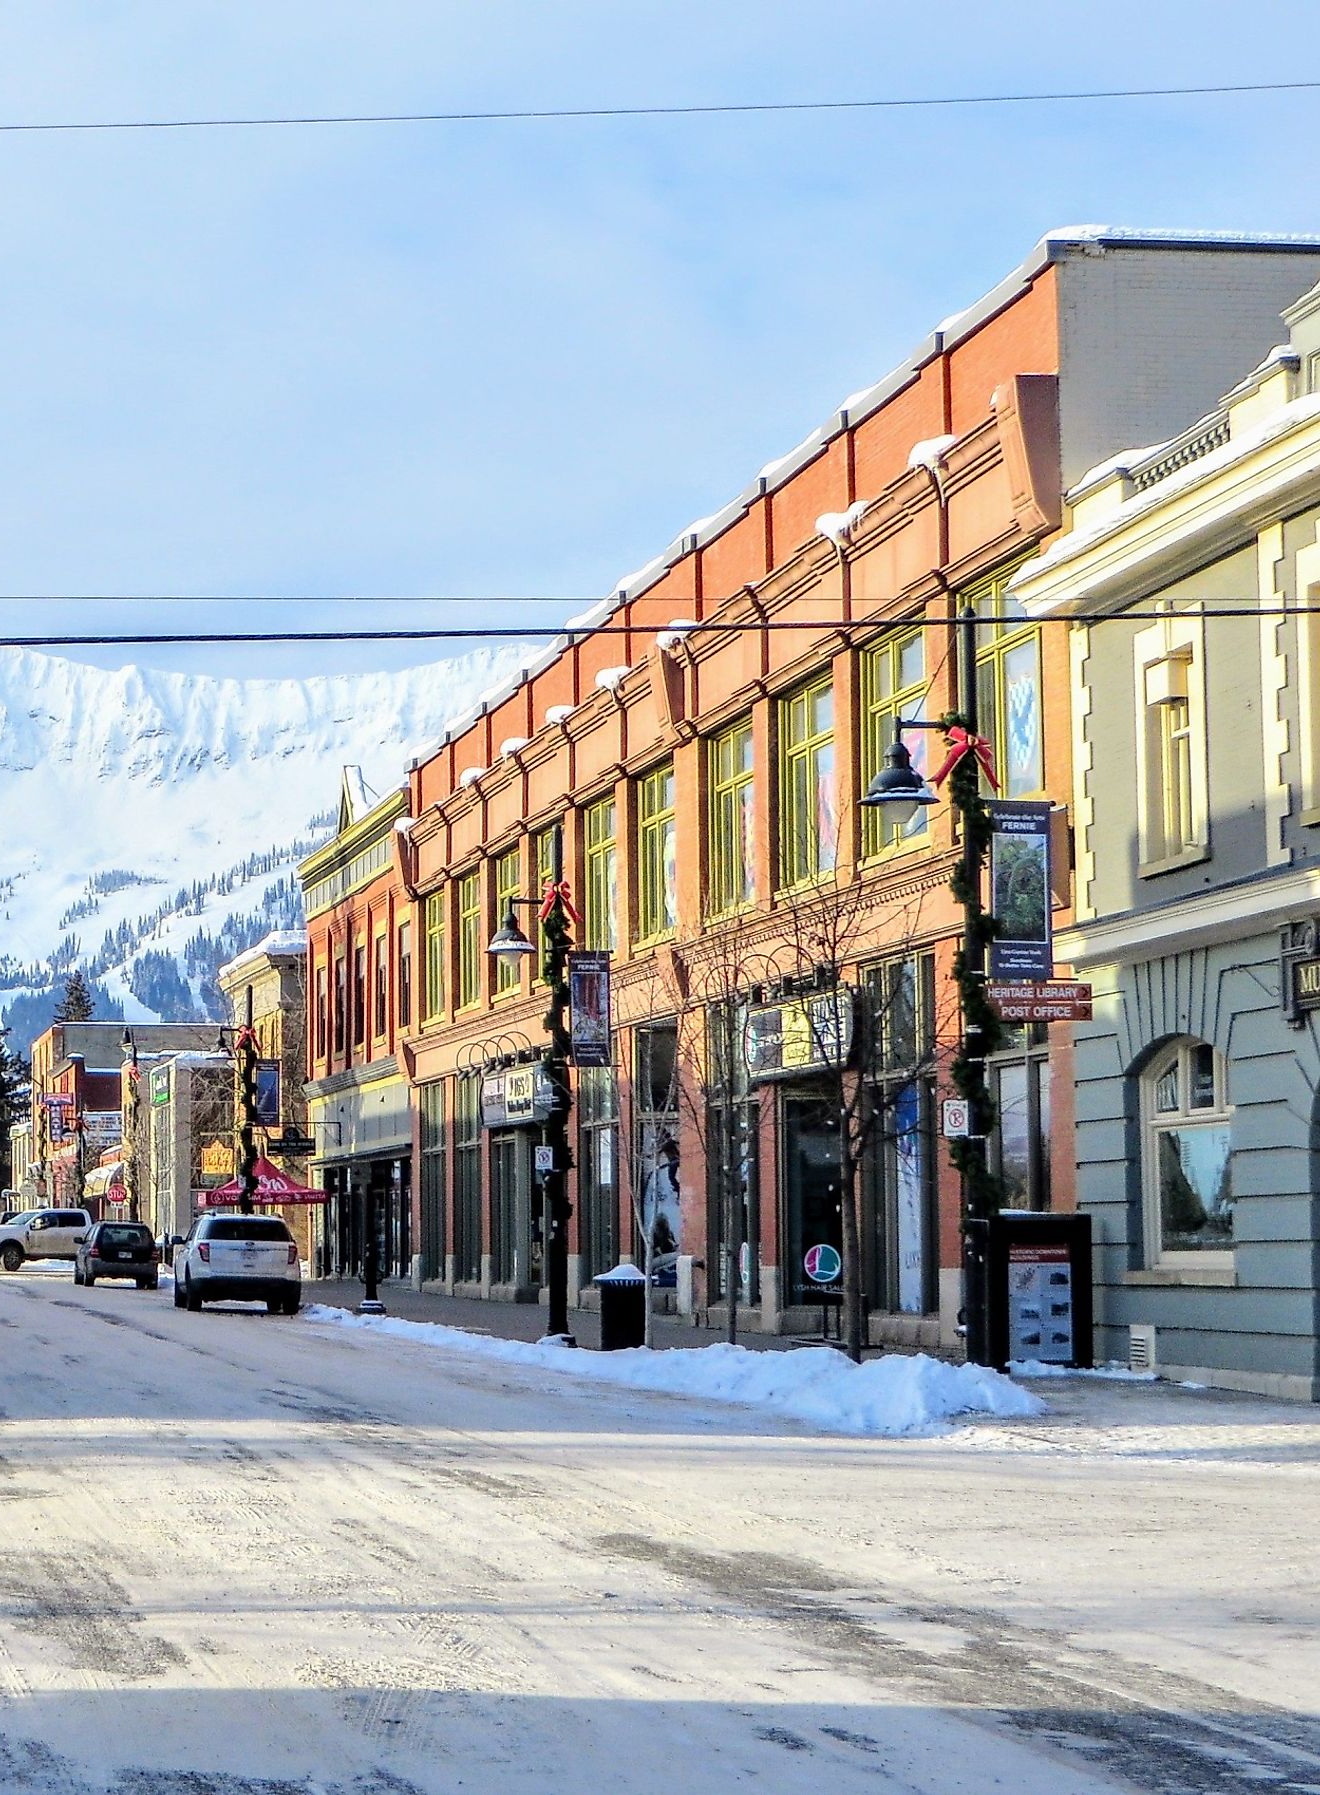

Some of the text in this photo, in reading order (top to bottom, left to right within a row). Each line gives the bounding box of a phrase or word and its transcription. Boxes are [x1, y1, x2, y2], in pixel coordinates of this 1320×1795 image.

[1001, 821, 1037, 830] FERNIE
[987, 987, 1078, 998] HERITAGE LIBRARY
[1001, 1006, 1072, 1017] POST OFFICE
[109, 1190, 126, 1199] STOP
